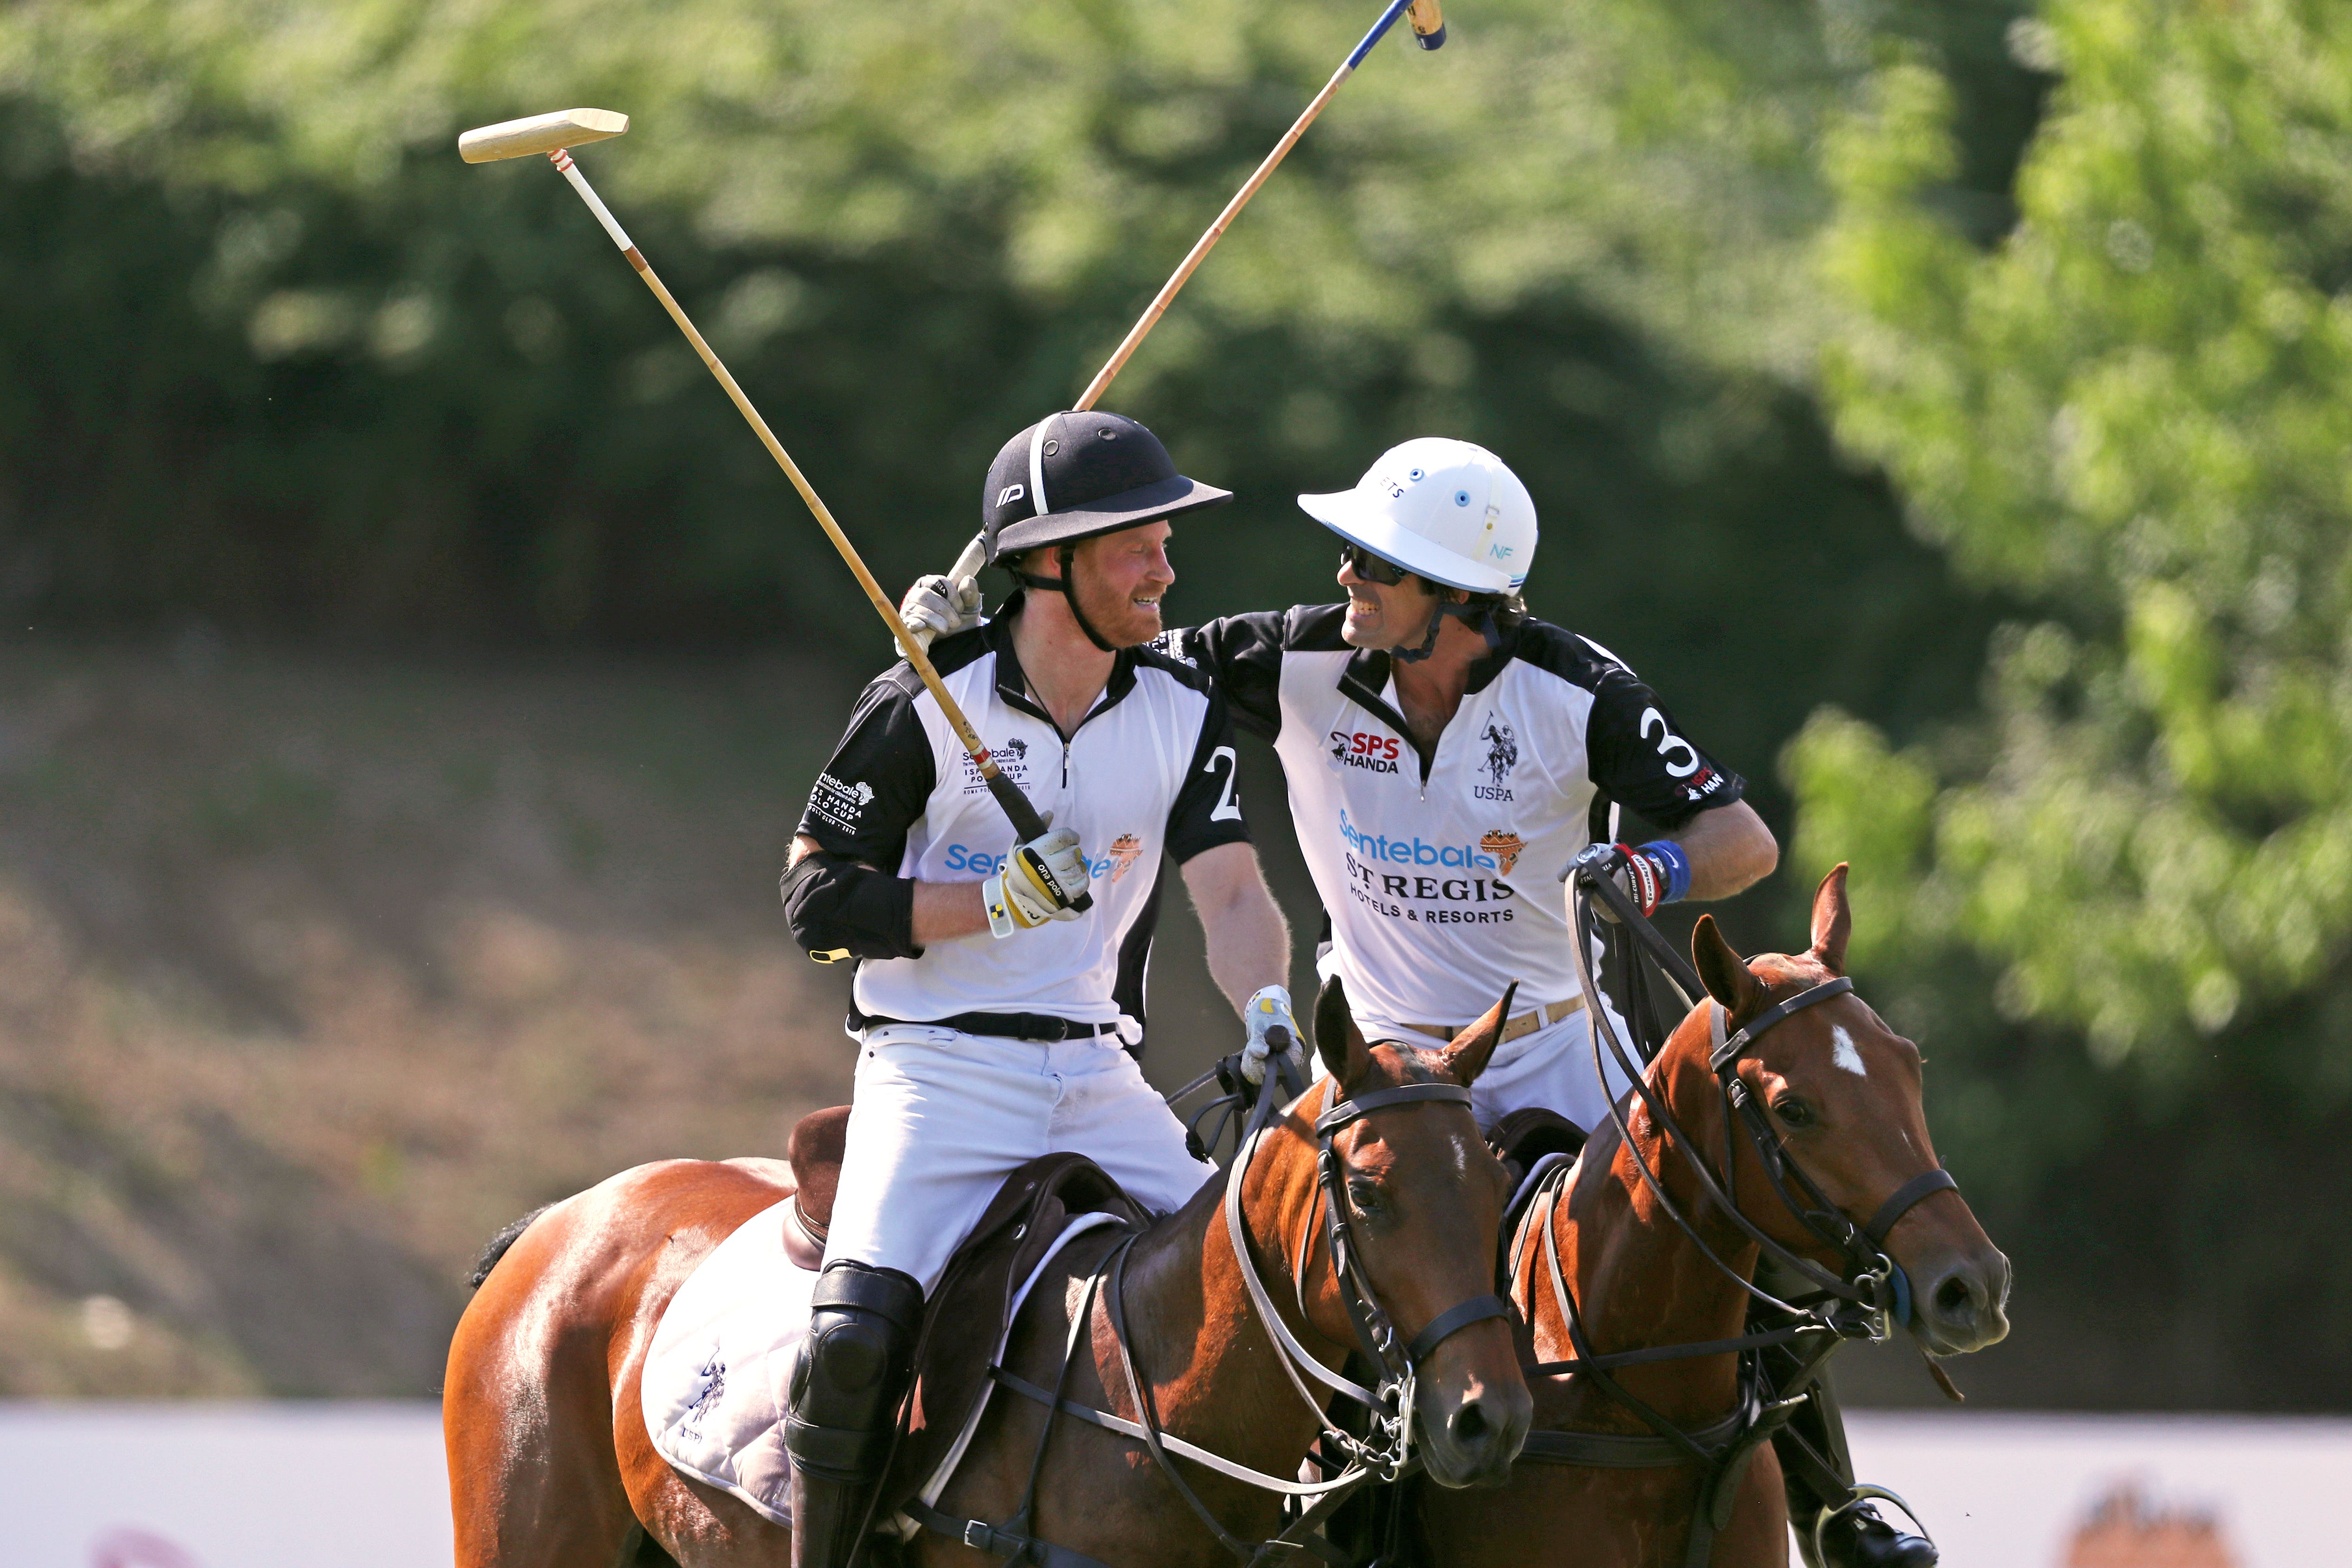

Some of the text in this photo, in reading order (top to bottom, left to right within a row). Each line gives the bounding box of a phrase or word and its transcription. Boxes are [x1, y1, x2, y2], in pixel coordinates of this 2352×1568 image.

[1490, 543, 1513, 559] NF
[1350, 732, 1399, 759] SPS
[1640, 707, 1699, 778] 3
[1343, 753, 1399, 774] HANDA
[1204, 746, 1242, 822] 2
[1474, 785, 1514, 801] USPA
[822, 815, 835, 825] CLUB
[827, 795, 862, 818] HANDA
[833, 807, 853, 820] CUP
[1340, 809, 1495, 869] Sentebale
[1038, 864, 1061, 896] ona polo
[1381, 874, 1515, 902] REGIS
[1629, 870, 1639, 903] TRI-CURVE
[1350, 882, 1514, 923] HOTELS & RESORTS
